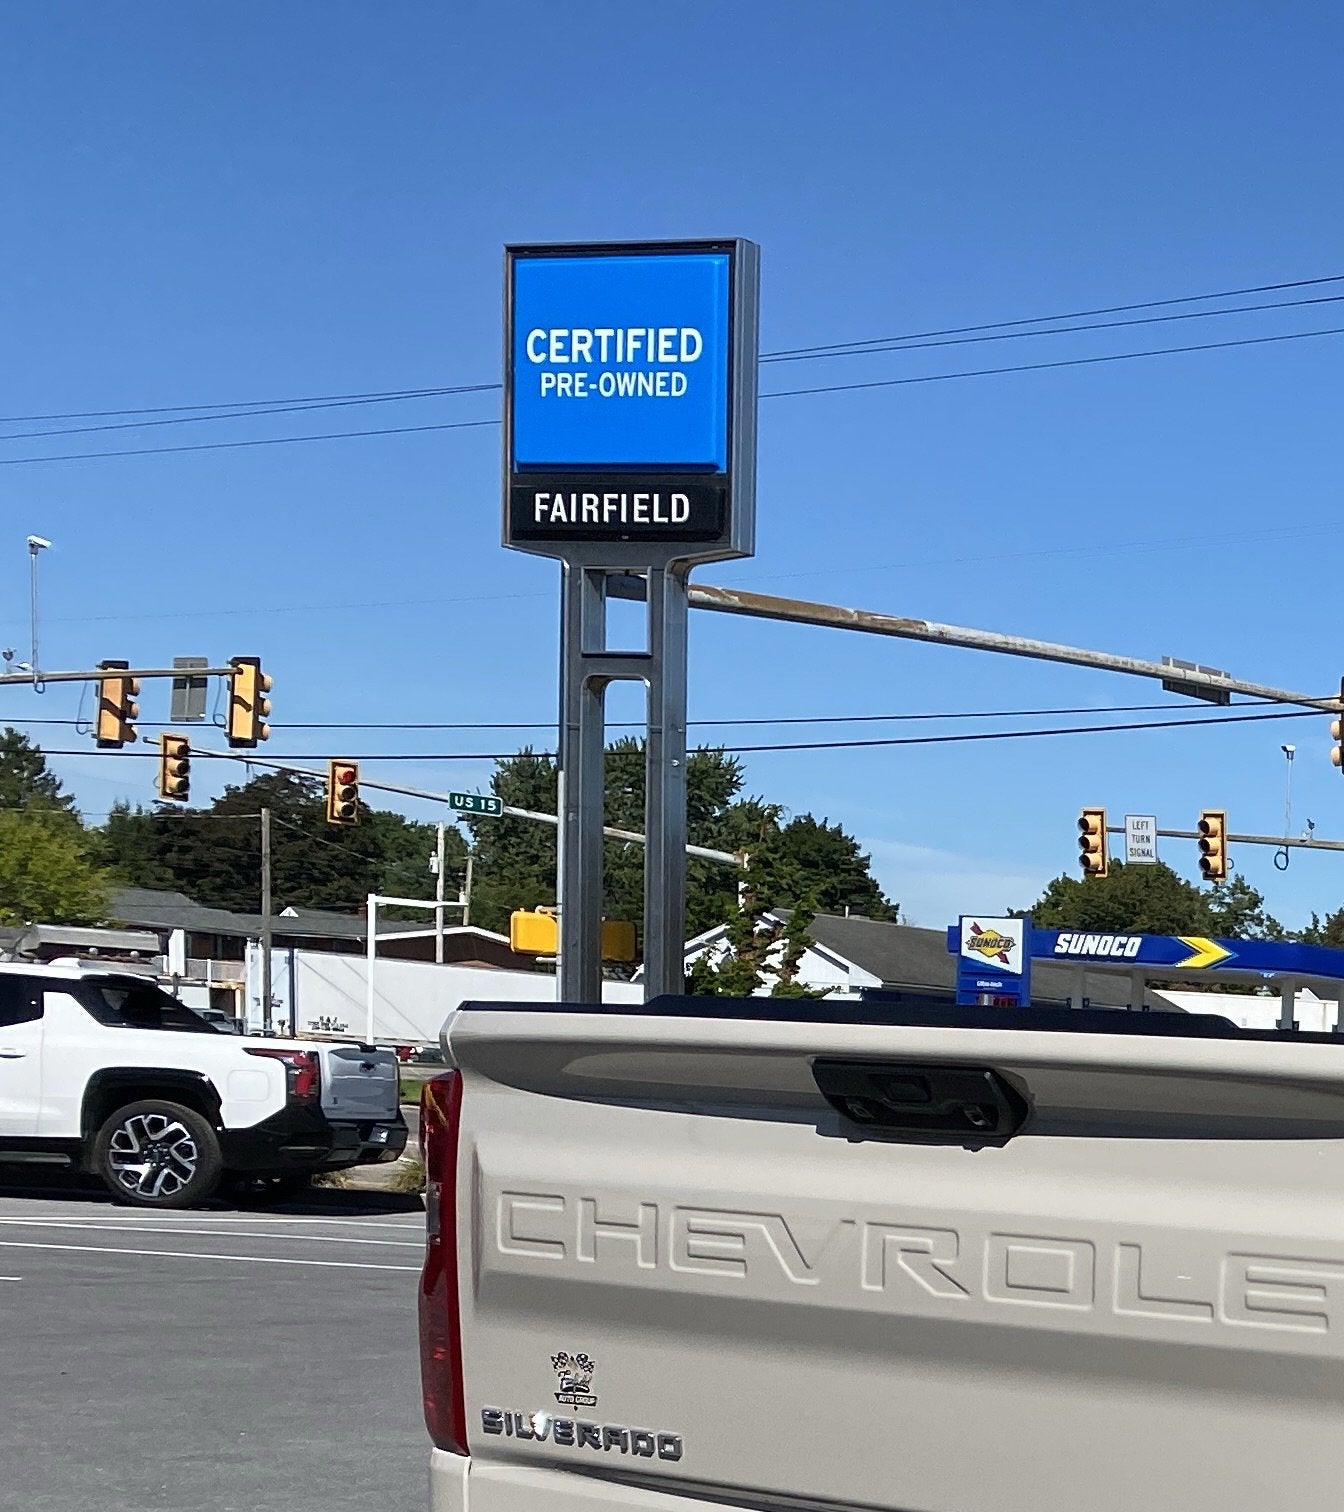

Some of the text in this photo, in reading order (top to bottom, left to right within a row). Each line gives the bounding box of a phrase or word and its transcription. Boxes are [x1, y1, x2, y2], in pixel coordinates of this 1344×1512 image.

[526, 327, 703, 363] CERTIFIED
[540, 371, 688, 398] PRE-OWNED
[534, 492, 690, 524] FAIRFIELD
[454, 795, 497, 811] US 15
[1132, 820, 1149, 830] LEFT
[1131, 833, 1151, 844] TURN
[1129, 847, 1154, 858] SIGNAL
[969, 936, 1012, 949] SUNOCO
[1054, 933, 1142, 957] SUNOCO
[481, 1405, 685, 1462] SILVERADO
